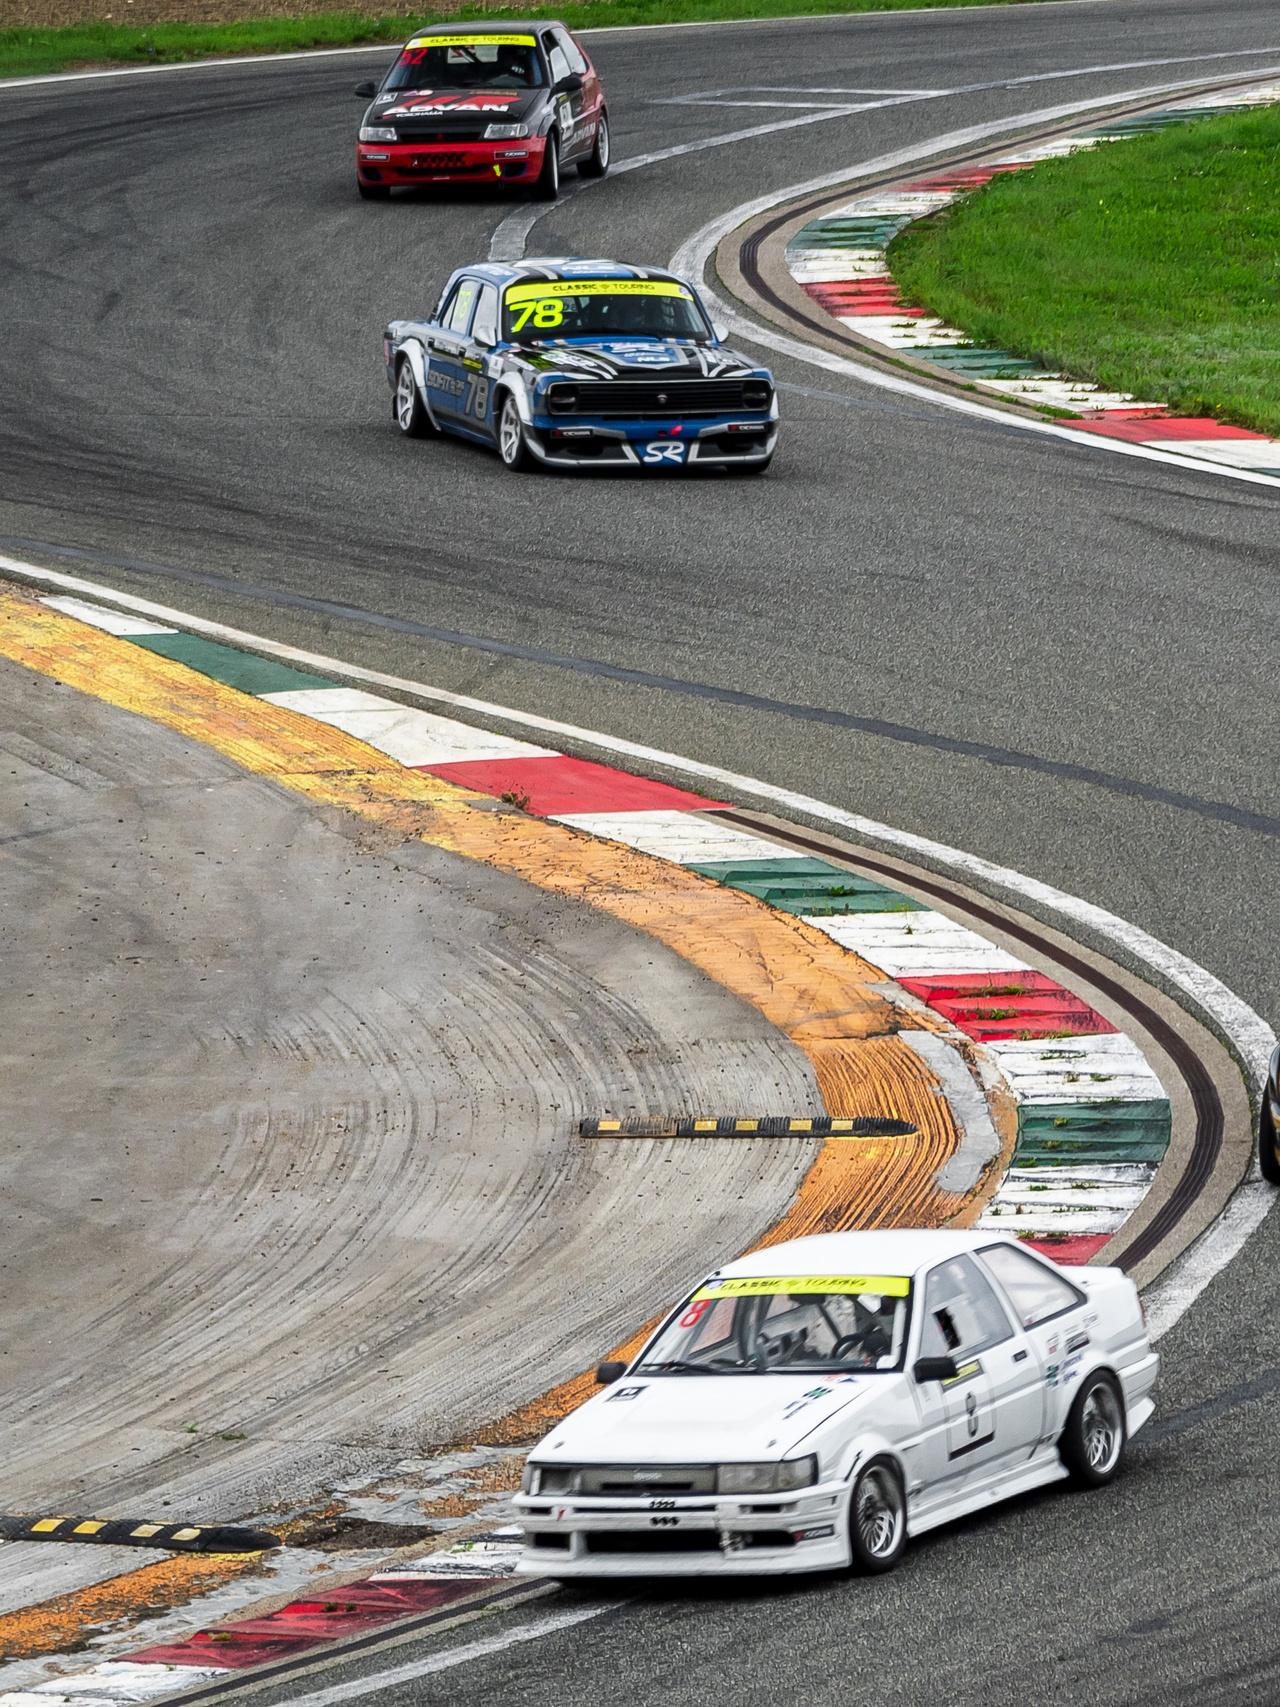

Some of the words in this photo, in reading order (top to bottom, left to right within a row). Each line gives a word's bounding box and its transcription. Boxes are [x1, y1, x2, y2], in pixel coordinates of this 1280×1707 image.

[400, 47, 427, 66] 52
[382, 103, 509, 115] ADVAN
[509, 299, 564, 334] 78
[466, 372, 489, 419] 78
[720, 1280, 780, 1291] CLASSIC
[805, 1278, 868, 1288] TOURING
[680, 1299, 712, 1329] 8
